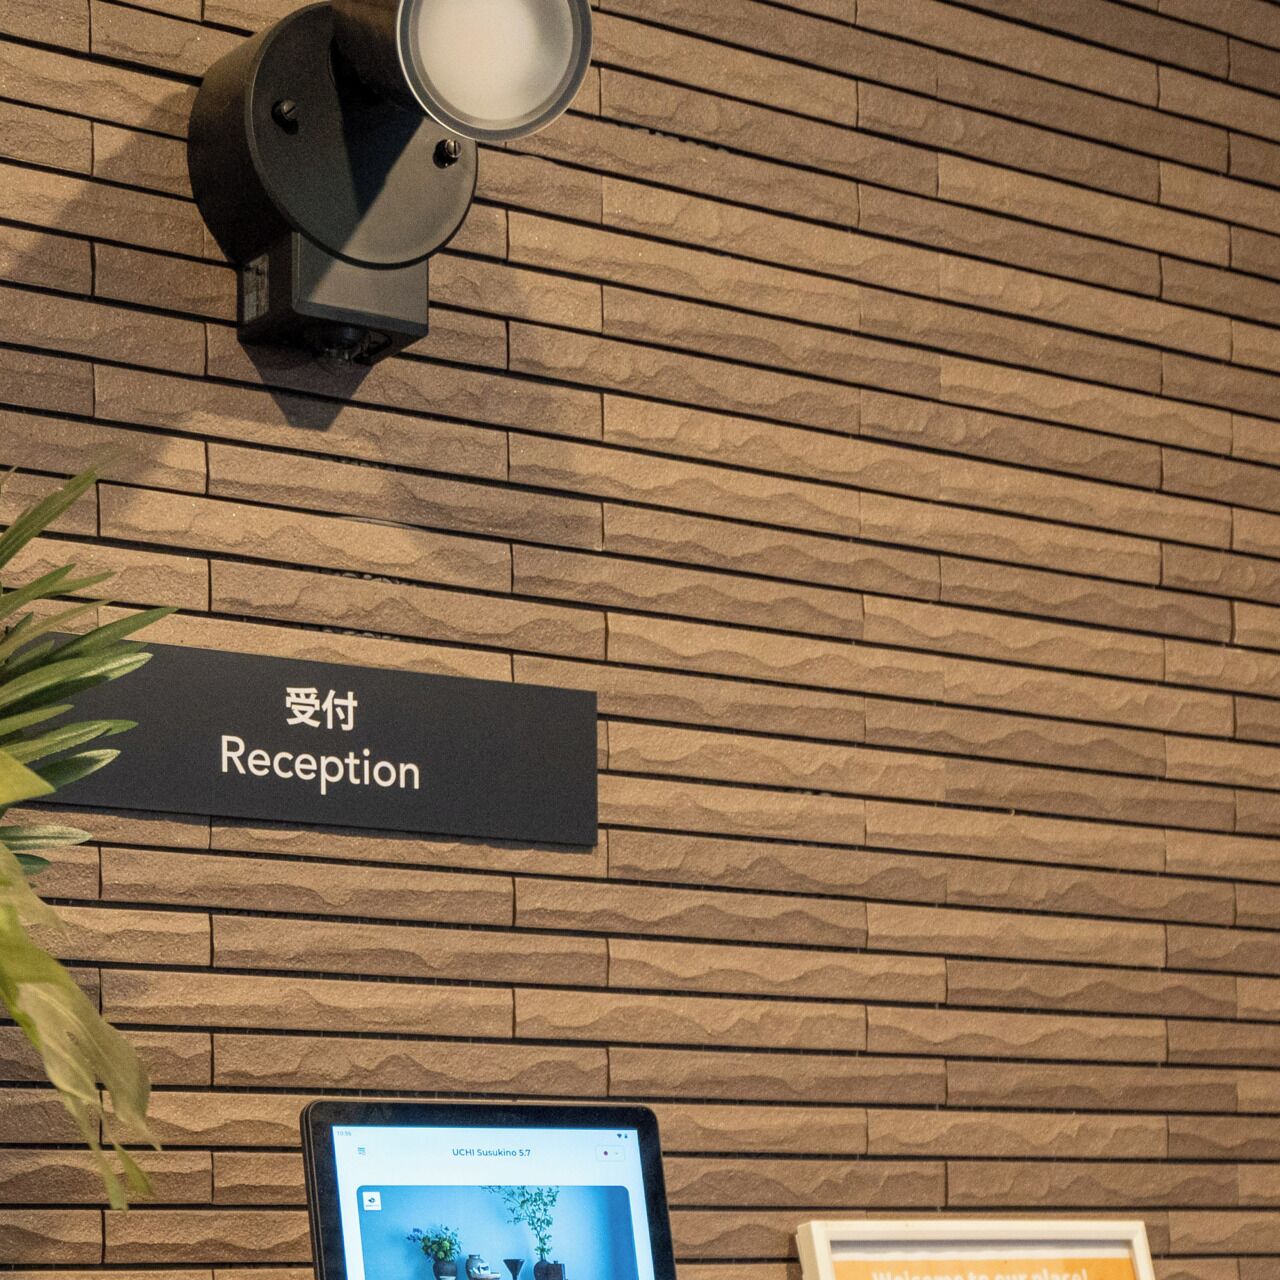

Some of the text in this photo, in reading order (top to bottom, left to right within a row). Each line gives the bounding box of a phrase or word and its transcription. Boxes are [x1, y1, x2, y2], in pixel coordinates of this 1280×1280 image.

[285, 687, 358, 732] 受付
[221, 735, 420, 795] Reception
[452, 1148, 531, 1157] UCHI Susukino 5.7
